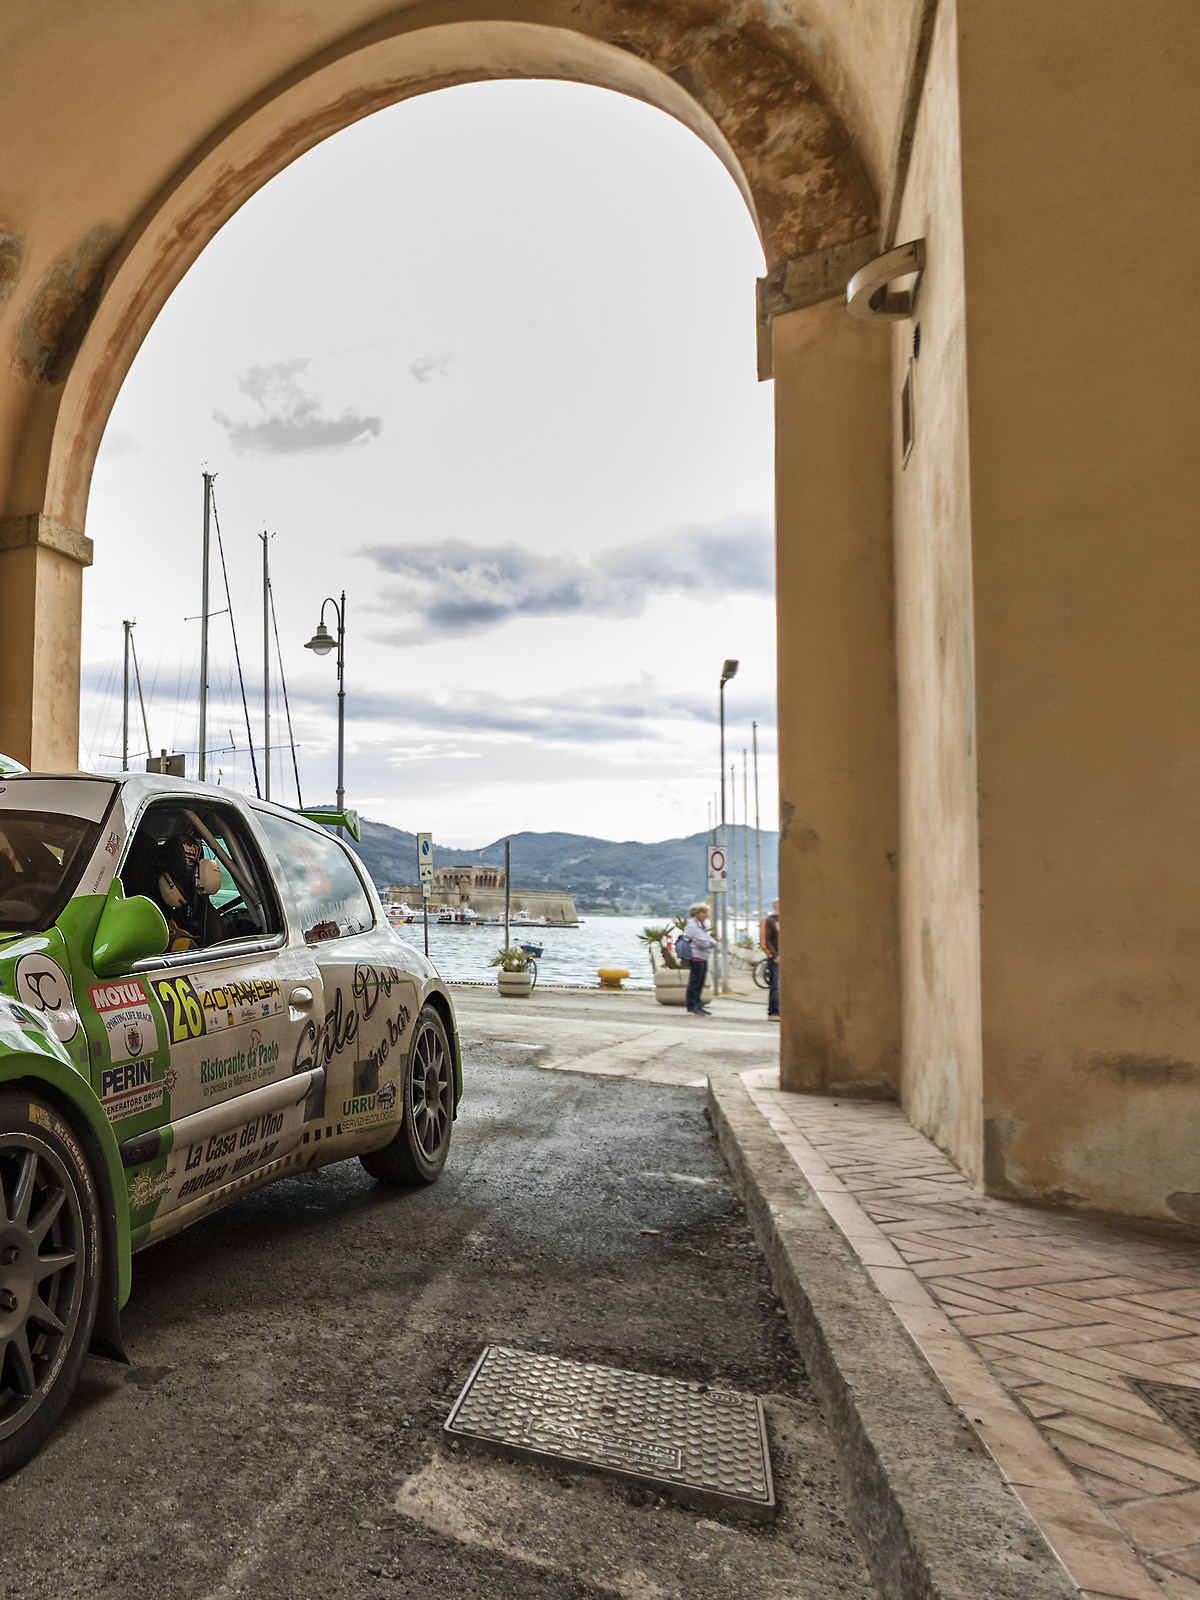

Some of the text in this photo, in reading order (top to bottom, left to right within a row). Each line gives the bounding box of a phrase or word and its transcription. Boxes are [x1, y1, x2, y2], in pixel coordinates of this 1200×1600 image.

[288, 838, 331, 895] 26
[92, 983, 146, 1009] MOTUL
[158, 978, 202, 1042] 26
[106, 1011, 153, 1032] SPORTING LIFE BEACH
[386, 1004, 411, 1047] bar
[102, 1058, 152, 1097] PERIN
[201, 1041, 279, 1084] Ristorante da Paolo
[203, 1085, 210, 1096] in
[210, 1080, 228, 1097] pineta
[233, 1073, 252, 1087] Marina
[252, 1071, 259, 1081] di
[258, 1065, 276, 1078] Campo
[143, 1089, 164, 1103] GROUP
[342, 1095, 376, 1116] URRU
[184, 1112, 284, 1171] La Casa del Vino
[341, 1115, 366, 1131] SERVIZI
[54, 1121, 93, 1194] MICHELIN
[178, 1163, 228, 1199] enoteca
[231, 1148, 260, 1175] wine
[259, 1140, 280, 1162] bar
[581, 1430, 677, 1456] MONTINI
